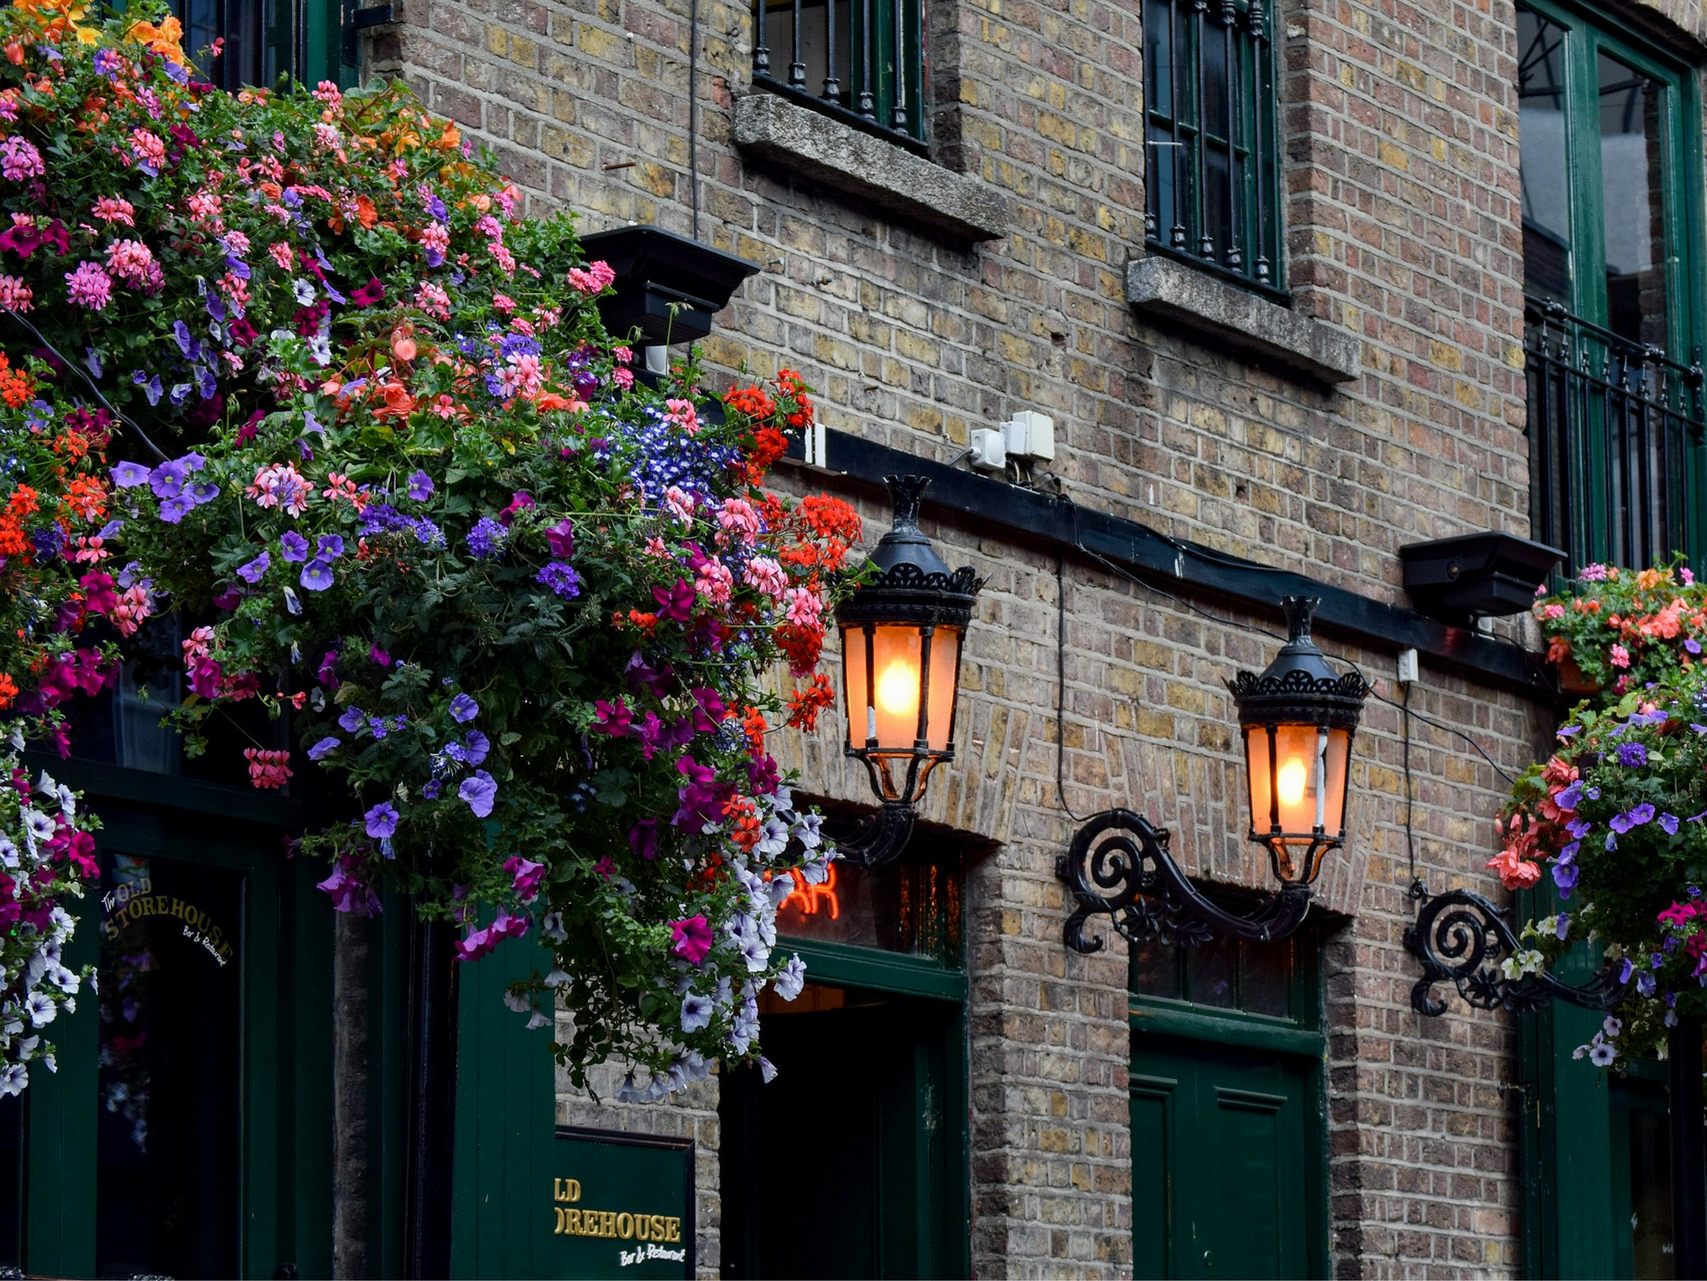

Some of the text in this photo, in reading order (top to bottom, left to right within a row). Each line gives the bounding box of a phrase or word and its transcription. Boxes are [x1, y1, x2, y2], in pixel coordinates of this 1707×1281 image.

[116, 877, 152, 902] OLD
[104, 895, 233, 964] STOREHOUSE
[183, 925, 194, 938] Bar
[202, 936, 227, 967] Restaurant
[619, 1251, 636, 1266] Bar
[646, 1243, 686, 1262] Restaurant
